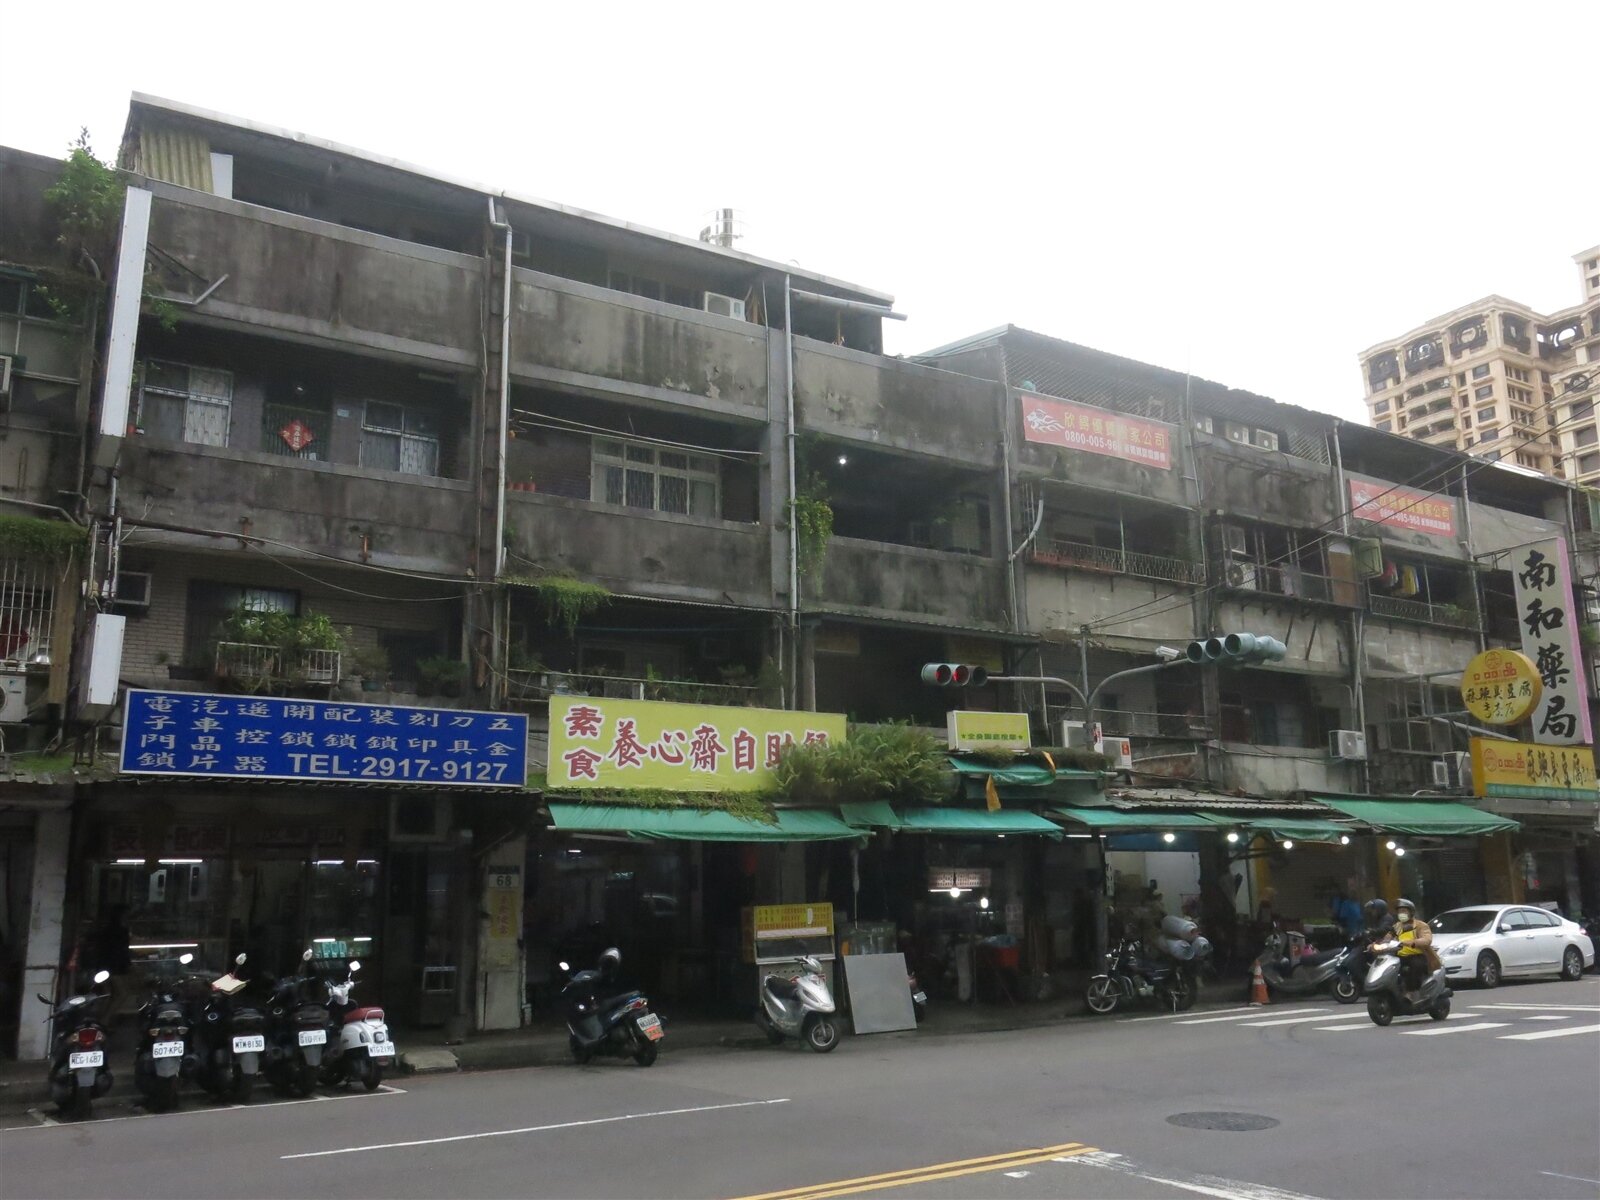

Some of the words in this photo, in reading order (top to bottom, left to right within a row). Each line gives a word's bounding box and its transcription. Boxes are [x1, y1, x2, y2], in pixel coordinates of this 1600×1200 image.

[1519, 550, 1577, 738] 南和藥局
[137, 696, 181, 769] 電子門鎖
[188, 699, 229, 770] 汽車晶片
[234, 702, 272, 772] 遙控器
[280, 705, 315, 748] 開鎖
[323, 708, 362, 750] 配鎖
[366, 709, 400, 752] 裝鎖
[408, 713, 439, 753] 刻印
[447, 716, 478, 755] 刀具
[485, 718, 516, 757] 五金
[564, 706, 602, 779] 素食
[288, 753, 508, 781] TEL:2917-9127
[496, 875, 512, 887] 68
